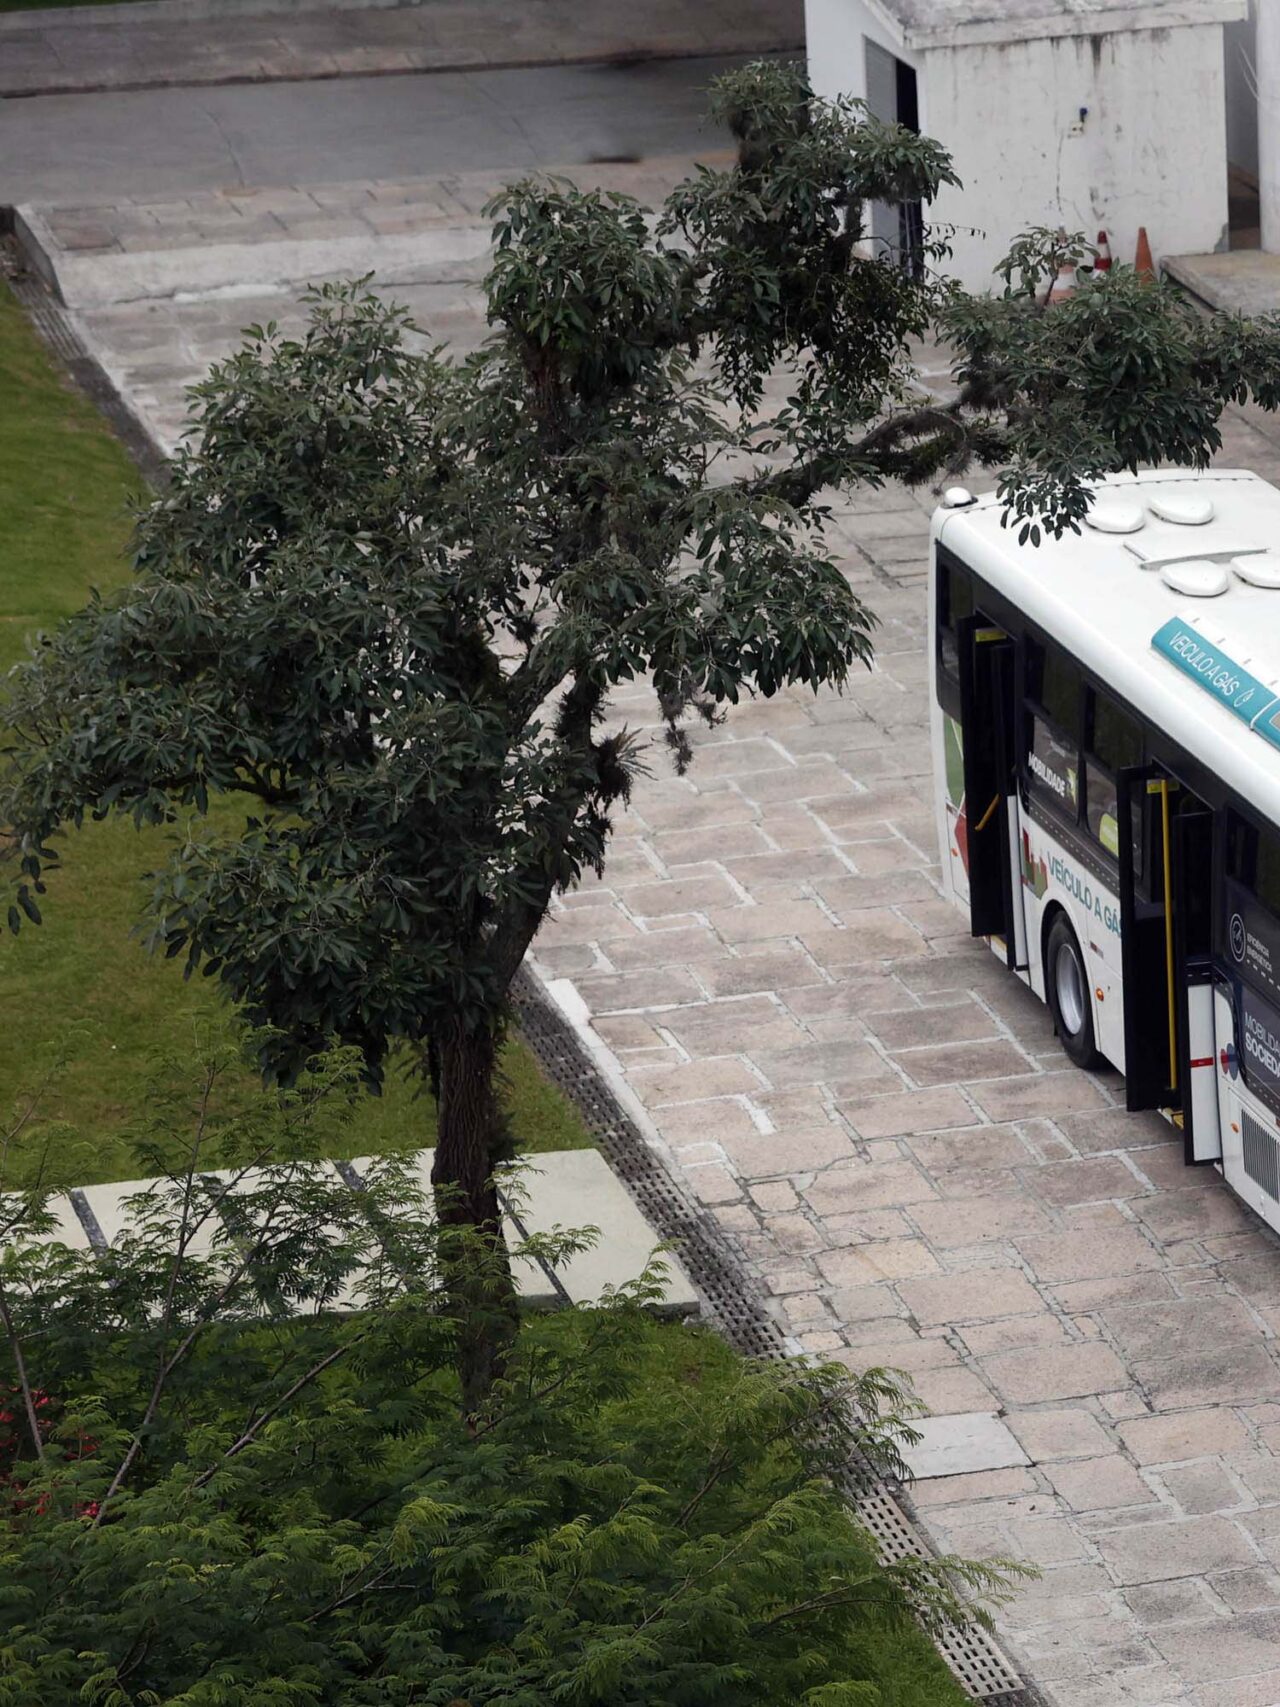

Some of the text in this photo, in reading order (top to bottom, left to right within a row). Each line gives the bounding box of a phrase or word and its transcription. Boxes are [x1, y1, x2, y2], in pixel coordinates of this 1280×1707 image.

[1204, 664, 1221, 680] A
[1028, 751, 1065, 798] MOBILIDADE
[1047, 851, 1121, 938] VEÍCULO A GÁ
